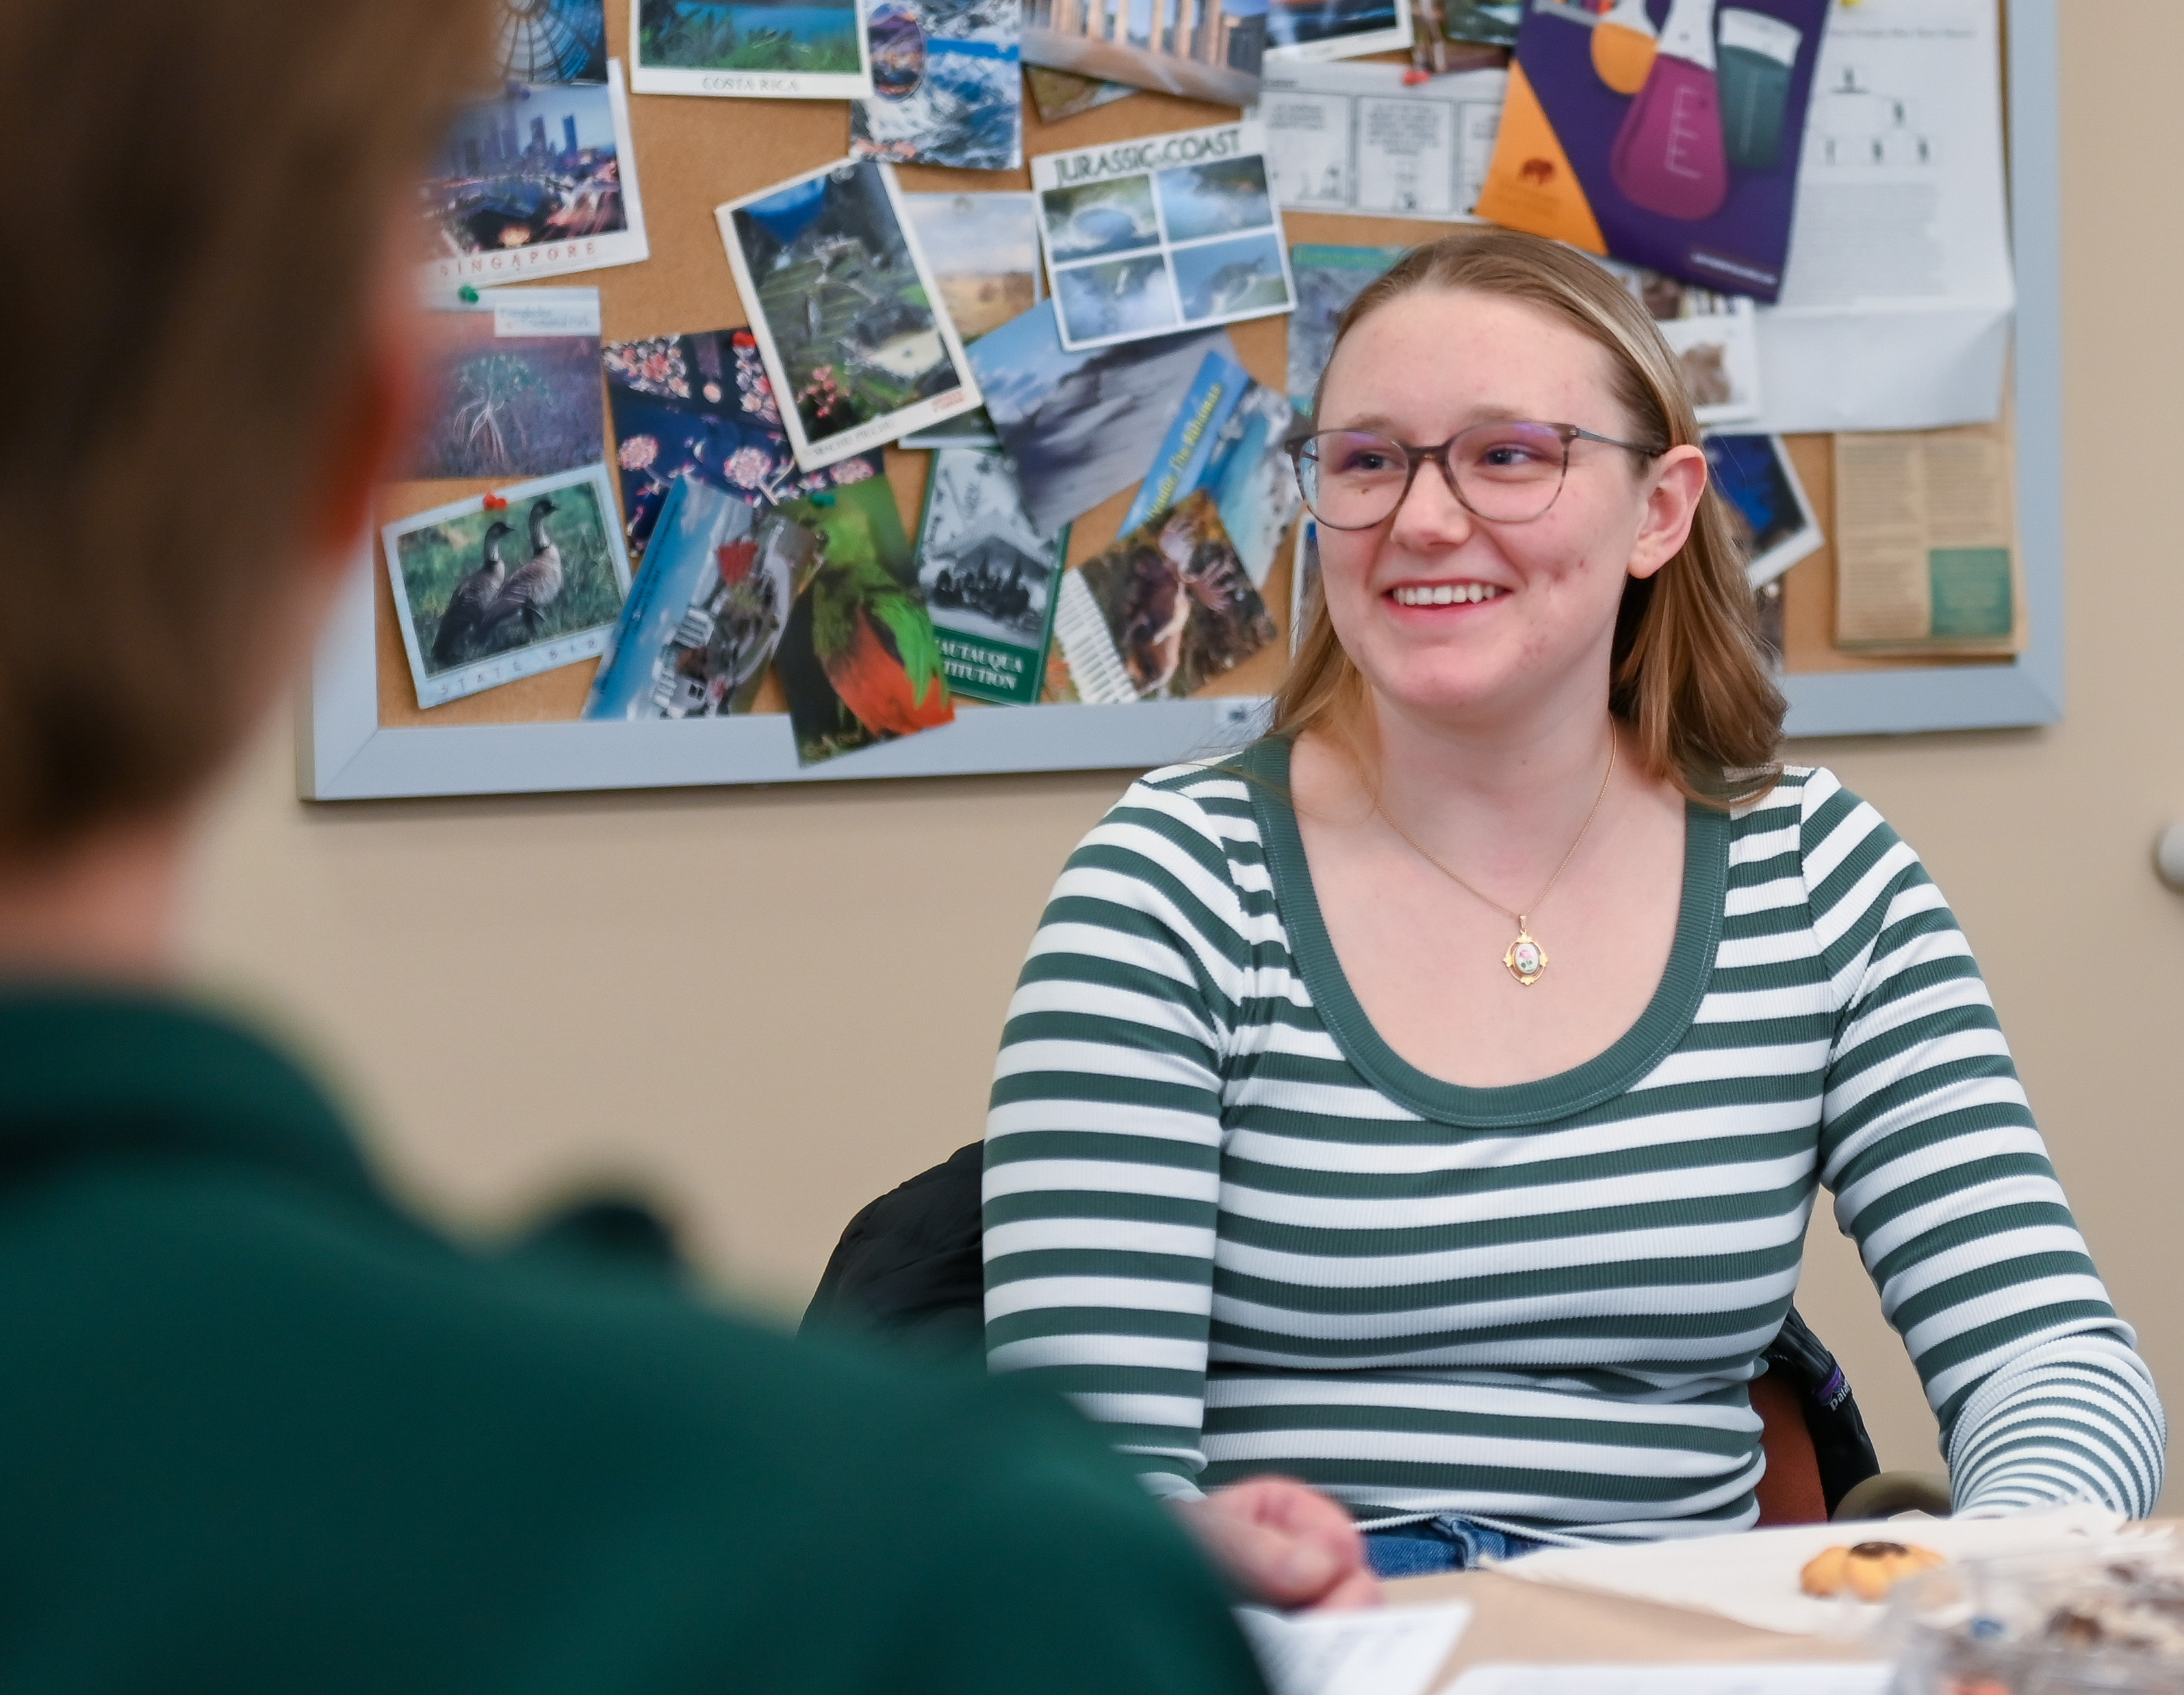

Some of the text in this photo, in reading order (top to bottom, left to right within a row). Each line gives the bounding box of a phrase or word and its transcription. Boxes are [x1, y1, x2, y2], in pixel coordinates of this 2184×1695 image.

[702, 77, 801, 92] COSTA RICA
[1054, 128, 1239, 188] JURASSIC COAST
[440, 242, 595, 277] SINGAPORE
[549, 637, 597, 661] BIR
[935, 638, 1024, 674] AUTAUQUA
[944, 660, 1018, 691] TITUTION
